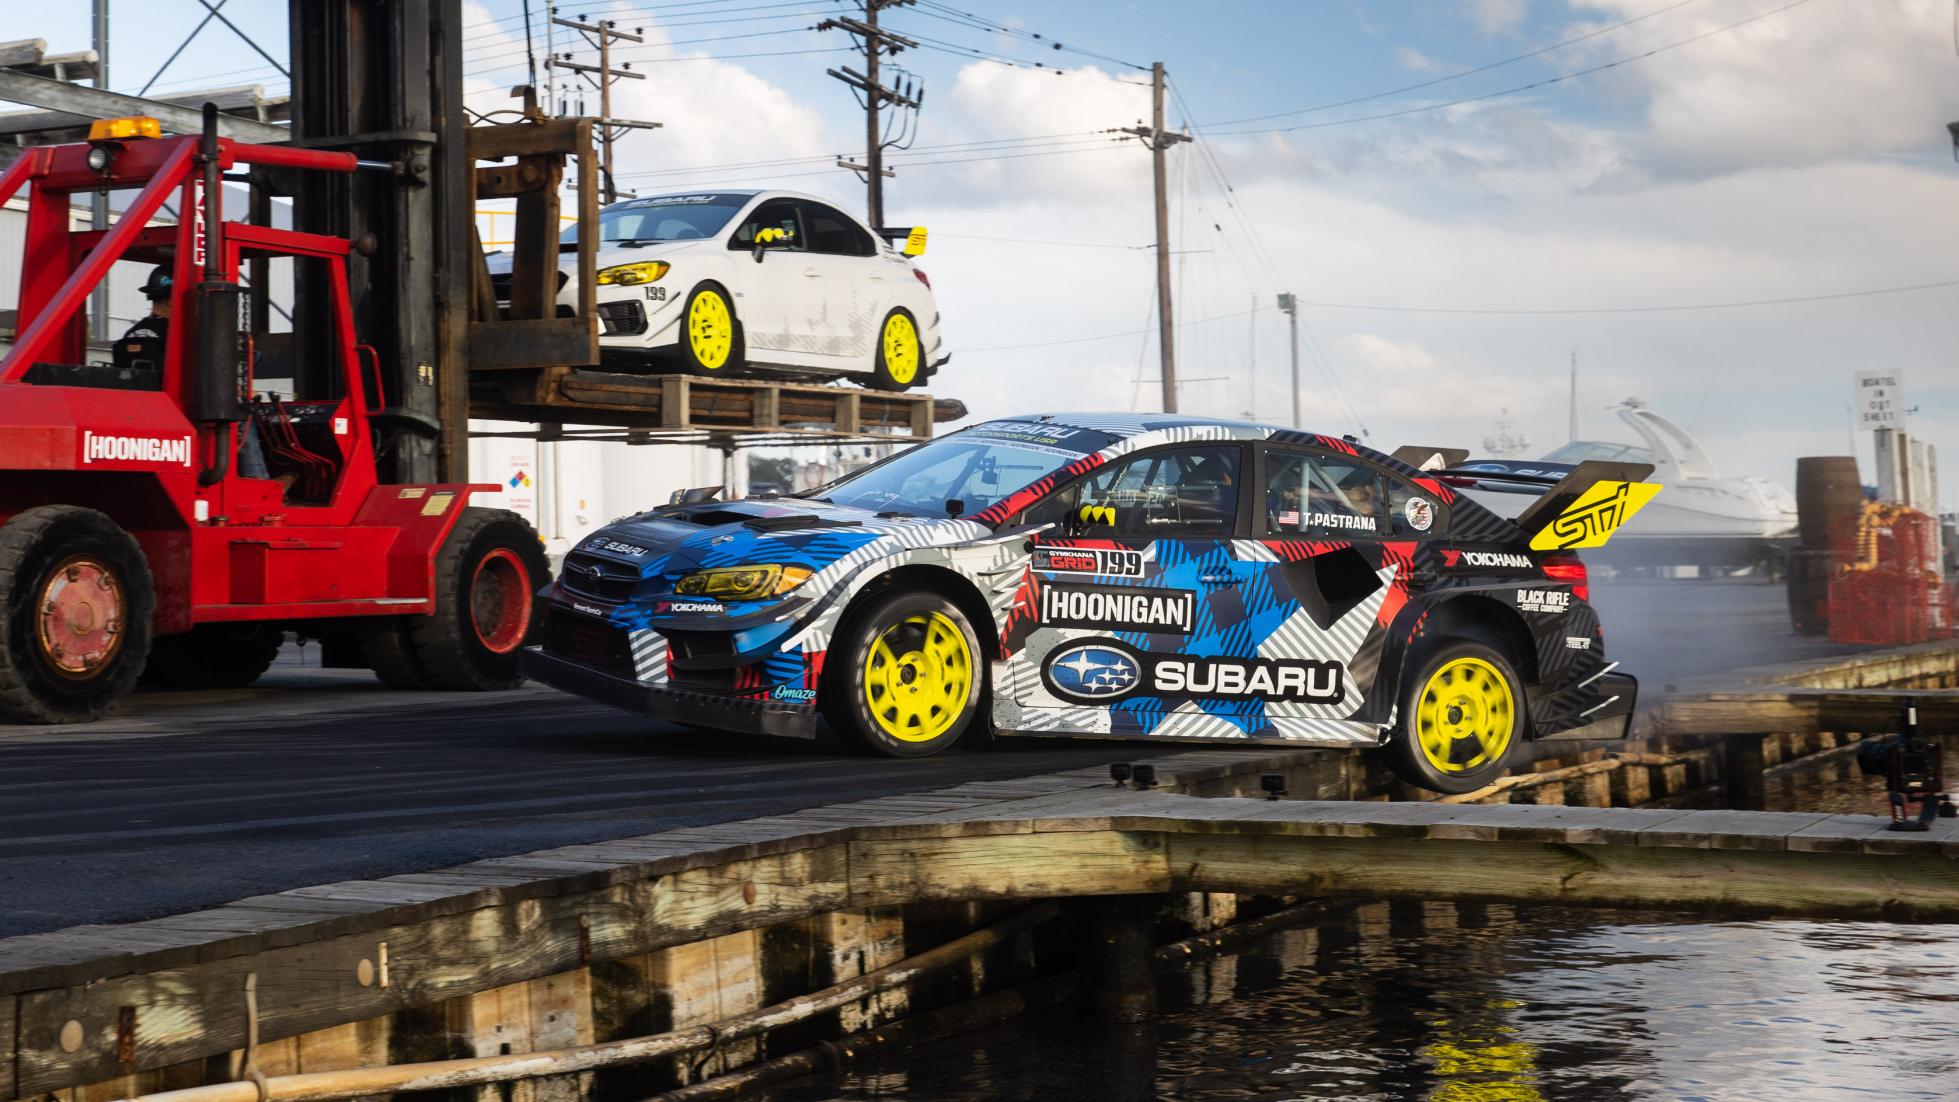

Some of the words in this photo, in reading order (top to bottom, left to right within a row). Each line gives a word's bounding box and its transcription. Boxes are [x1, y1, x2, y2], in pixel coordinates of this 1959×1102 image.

[644, 286, 666, 301] 199
[979, 422, 1081, 439] SUBARU
[84, 431, 192, 467] [HOONIGAN]
[604, 541, 649, 557] SUBARU
[1049, 550, 1094, 559] GYMKHANA
[1098, 551, 1142, 576] 199
[1462, 552, 1533, 568] YOKOHAMA
[1517, 589, 1546, 605] BLACK
[1546, 591, 1570, 607] RIFLE
[670, 602, 724, 613] YOKOHAMA
[1042, 584, 1193, 632] [HOONIGAN]
[1521, 603, 1540, 612] COFFEE
[1540, 604, 1565, 613] COMPANY
[1154, 660, 1337, 698] SUBARU
[774, 685, 817, 699] Omaze
